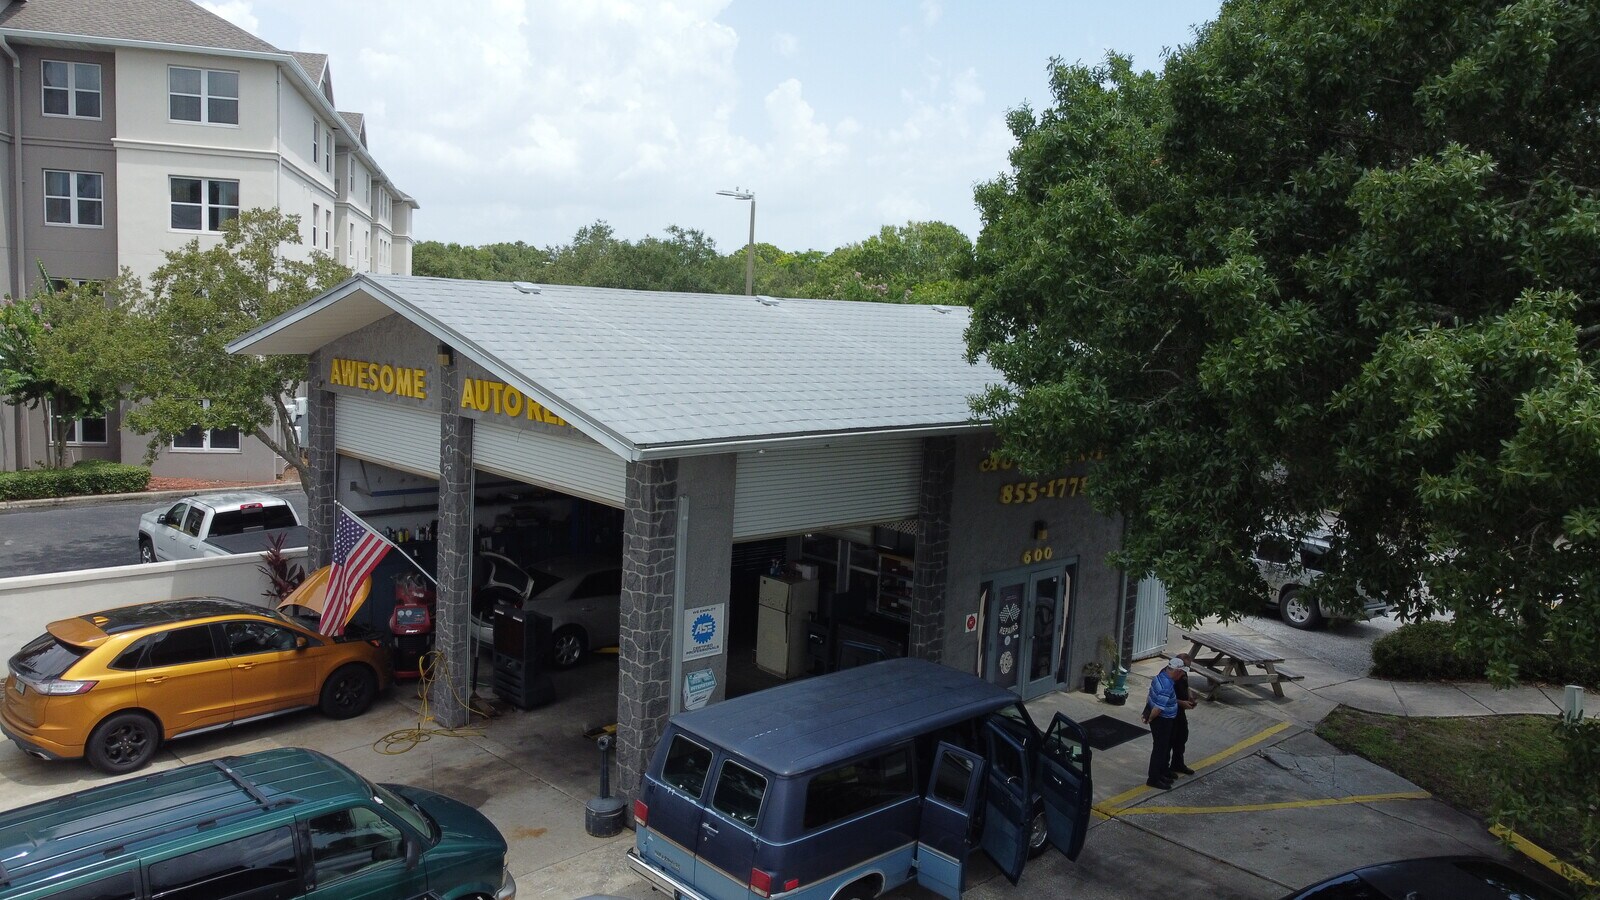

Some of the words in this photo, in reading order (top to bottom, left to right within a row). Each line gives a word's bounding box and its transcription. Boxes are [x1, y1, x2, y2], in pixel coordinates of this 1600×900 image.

[330, 358, 427, 399] AWESOME
[461, 378, 522, 417] AUTO
[1022, 547, 1053, 564] 600
[694, 622, 713, 635] ASE
[999, 622, 1019, 635] REPAIRS
